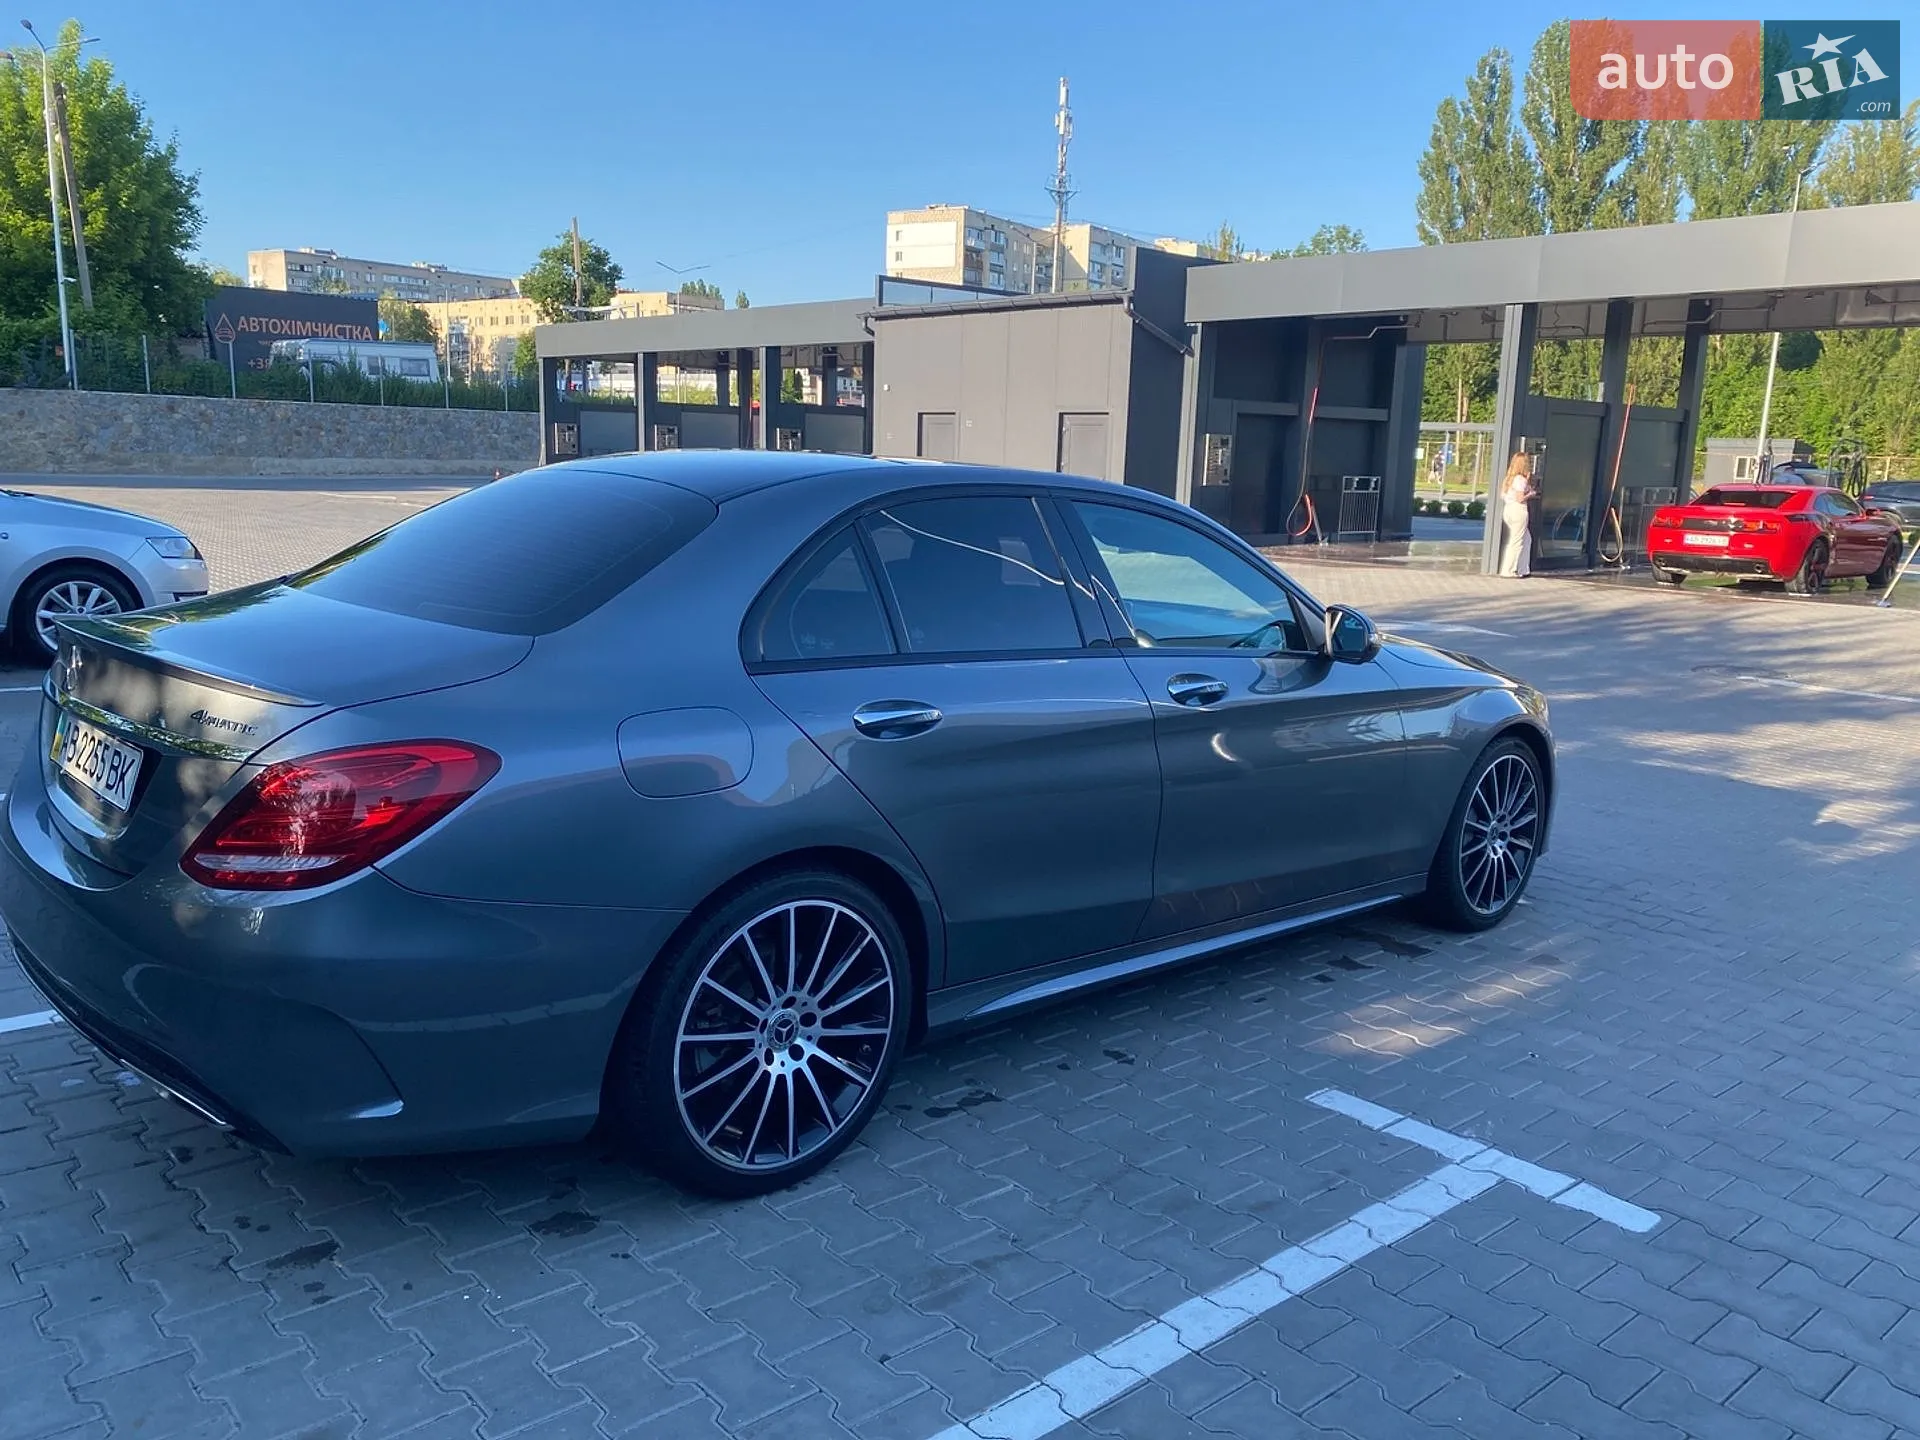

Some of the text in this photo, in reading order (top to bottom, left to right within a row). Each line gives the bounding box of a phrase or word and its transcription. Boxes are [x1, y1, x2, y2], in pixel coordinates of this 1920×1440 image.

[237, 315, 373, 341] АВТОХІМЧИСТКА
[60, 721, 135, 800] AB 2255 BK
